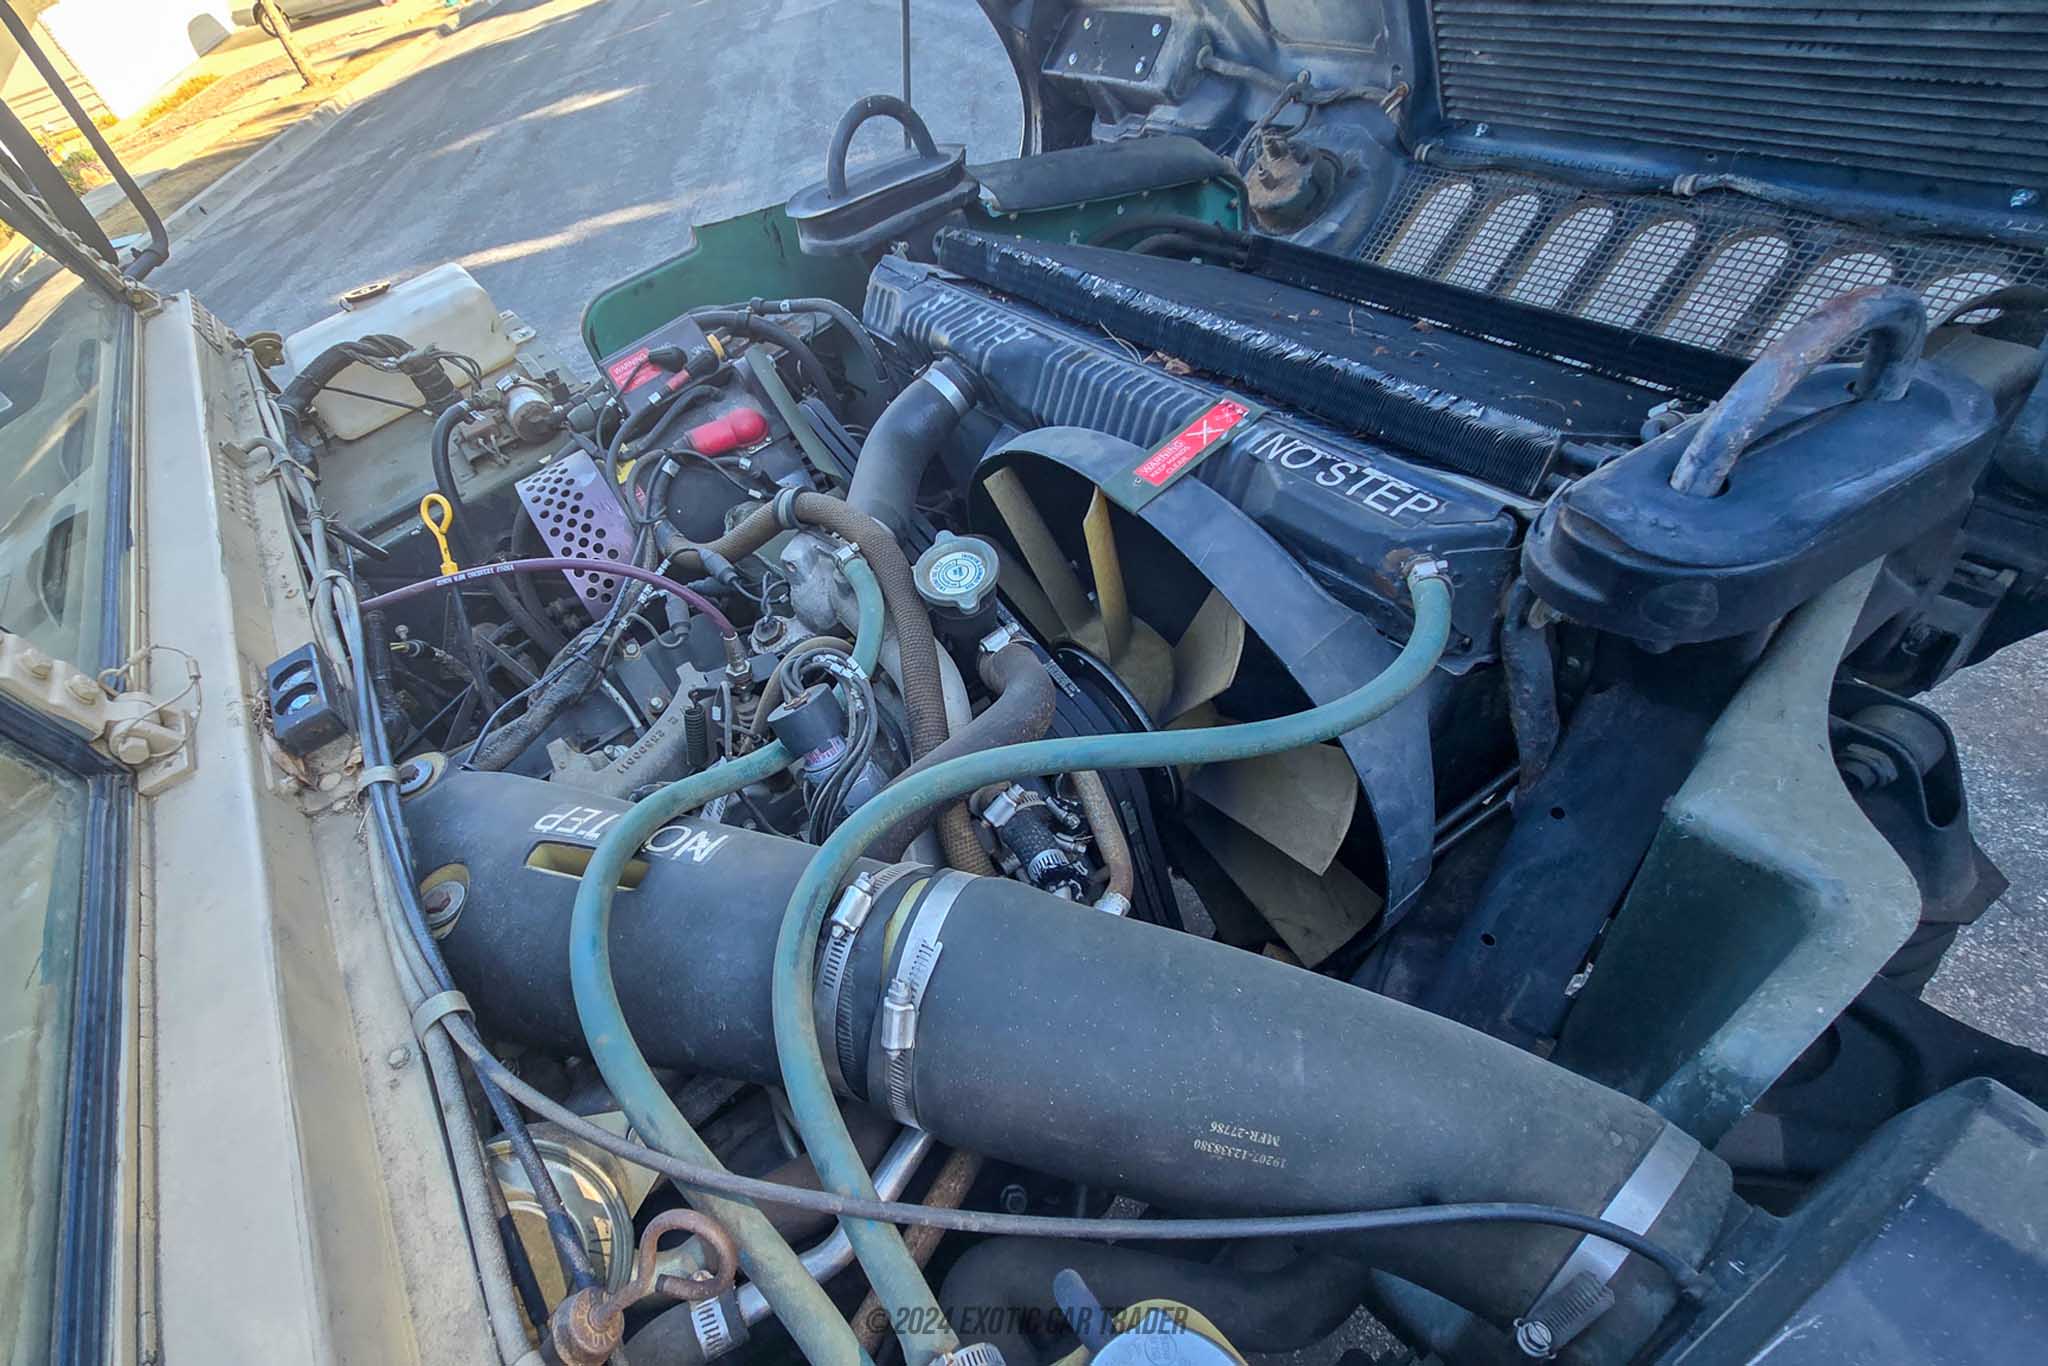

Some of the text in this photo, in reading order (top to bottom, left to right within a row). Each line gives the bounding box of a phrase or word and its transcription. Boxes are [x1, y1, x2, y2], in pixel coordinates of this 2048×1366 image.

[1142, 441, 1185, 473] WARNING
[1254, 433, 1438, 517] NO STEP
[534, 806, 728, 862] NO TEP
[1209, 1121, 1280, 1147] MFR-27786
[1193, 1139, 1288, 1169] 19207-12338380
